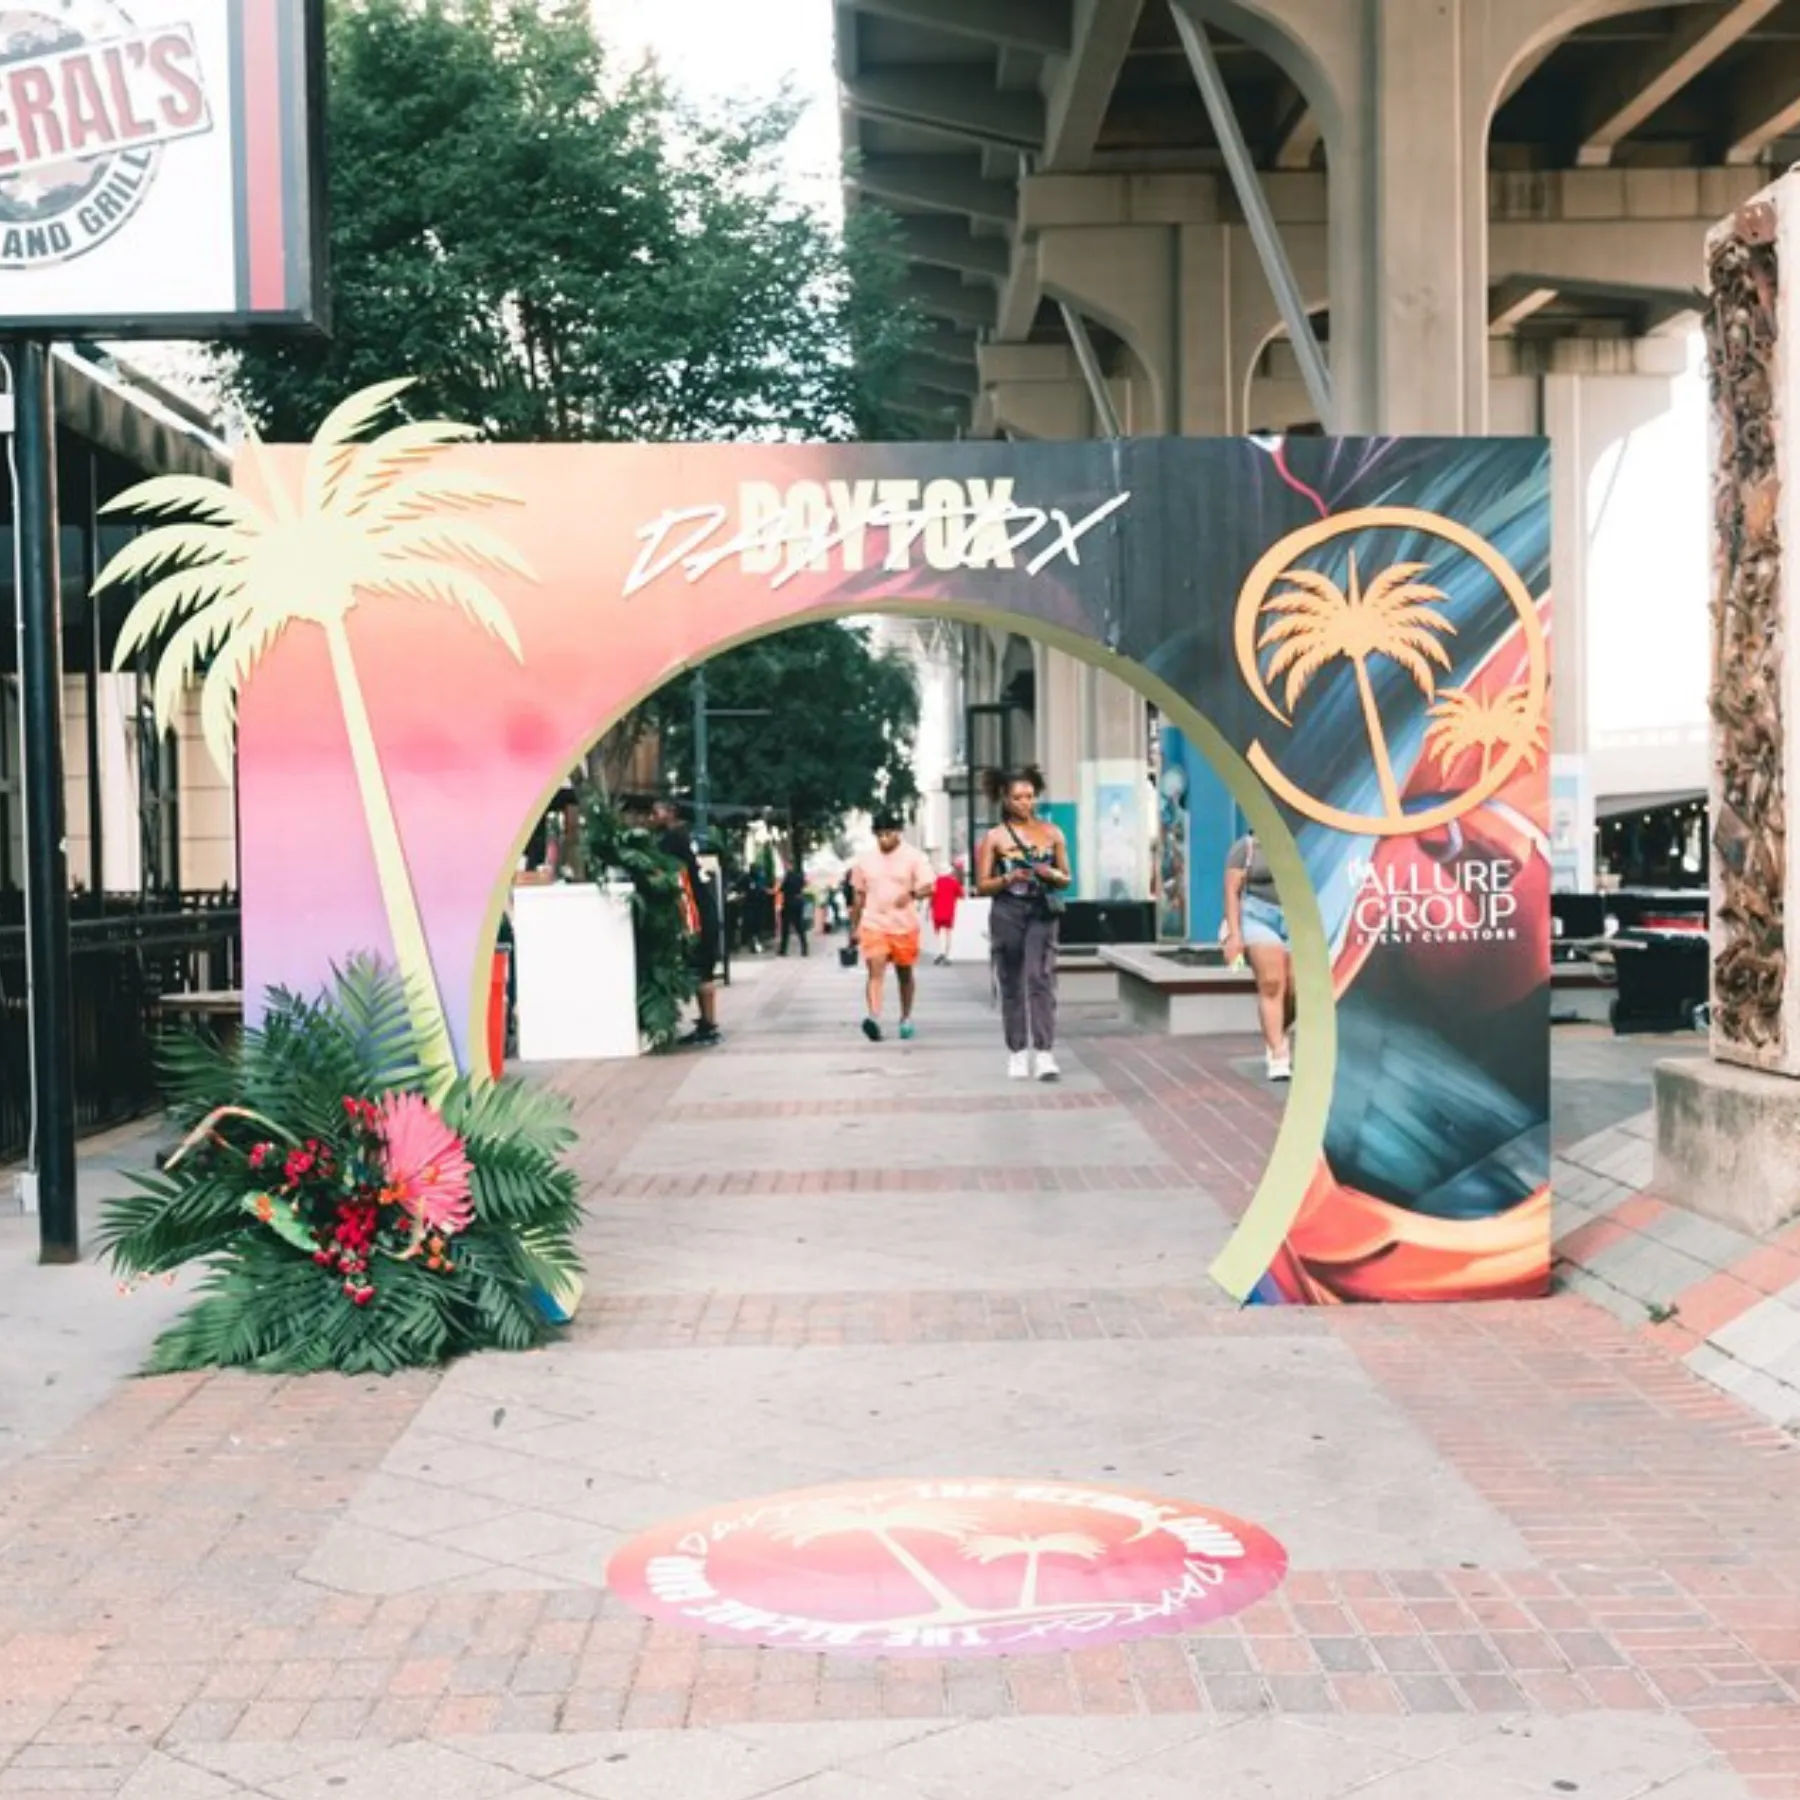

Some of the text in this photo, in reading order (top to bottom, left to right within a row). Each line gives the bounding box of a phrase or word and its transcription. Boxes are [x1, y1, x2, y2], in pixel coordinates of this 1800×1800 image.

[2, 150, 151, 259] AND GRILL
[739, 478, 1015, 573] DAYTOX
[1356, 859, 1514, 897] ALLURE
[1355, 893, 1517, 932] GROUP
